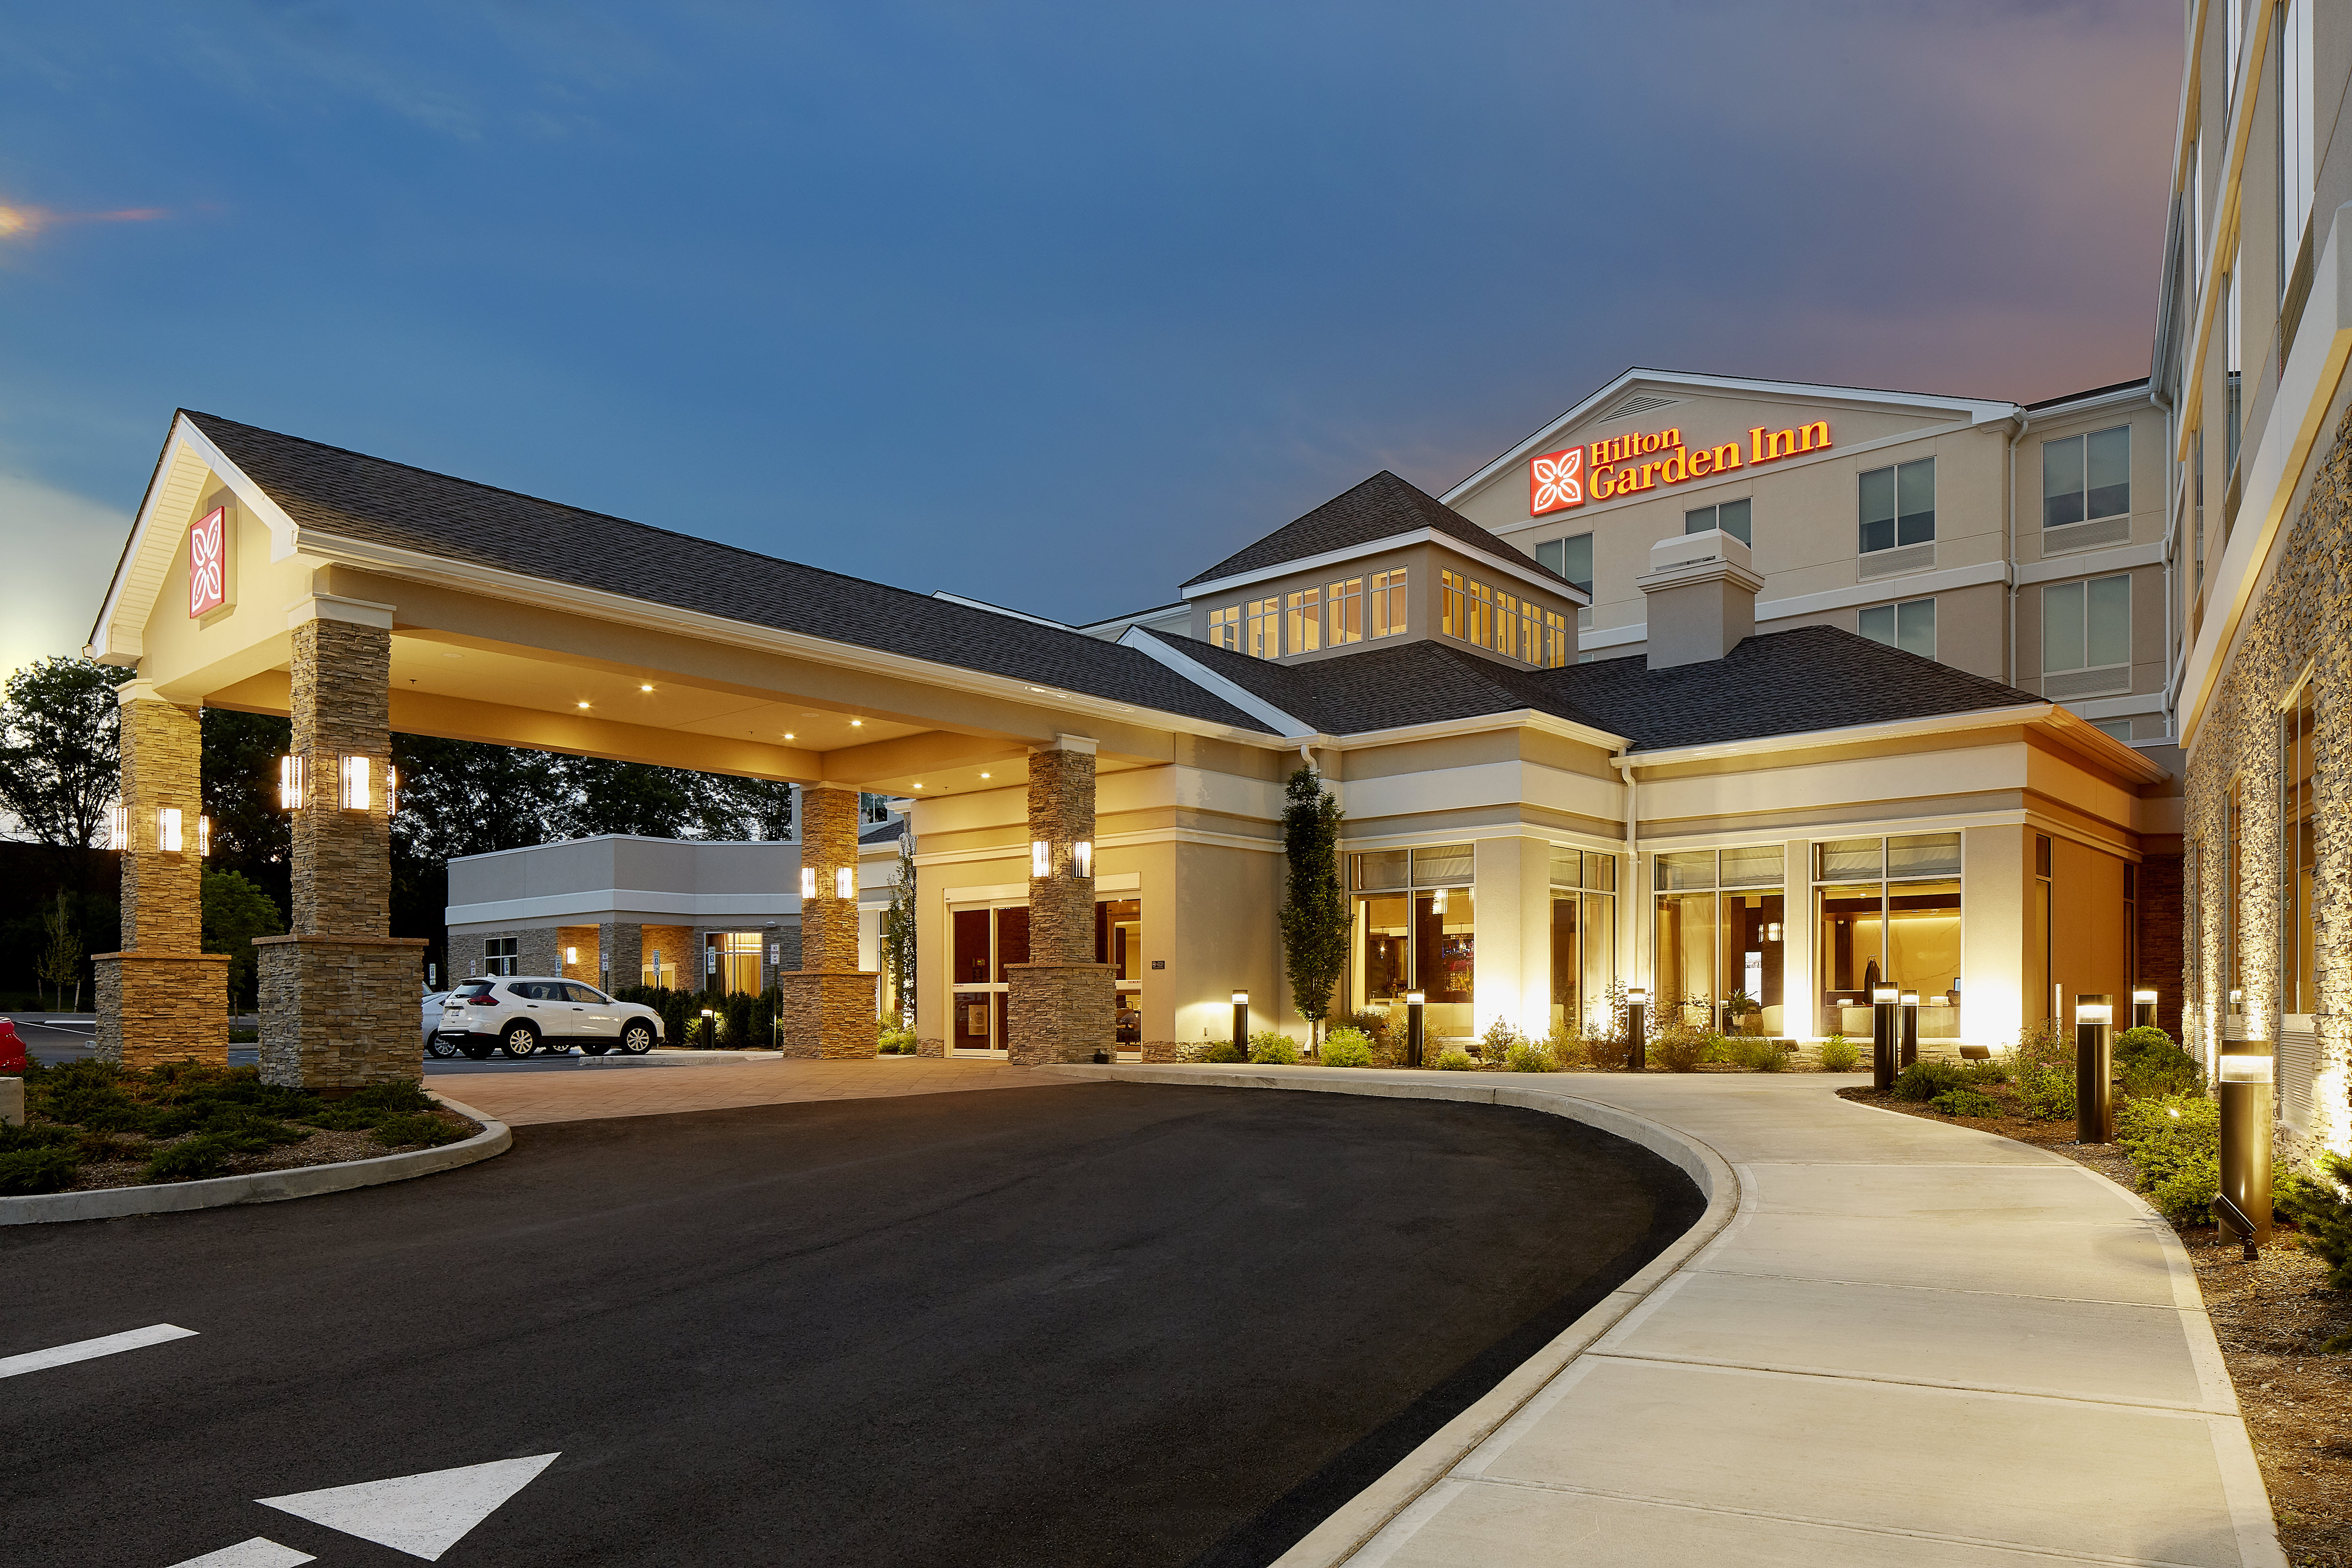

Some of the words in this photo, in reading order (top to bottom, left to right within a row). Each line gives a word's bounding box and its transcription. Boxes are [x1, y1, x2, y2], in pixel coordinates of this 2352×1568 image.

[1589, 427, 1682, 467] Hilton
[1589, 446, 1743, 500] Garden
[1748, 420, 1832, 464] Inn
